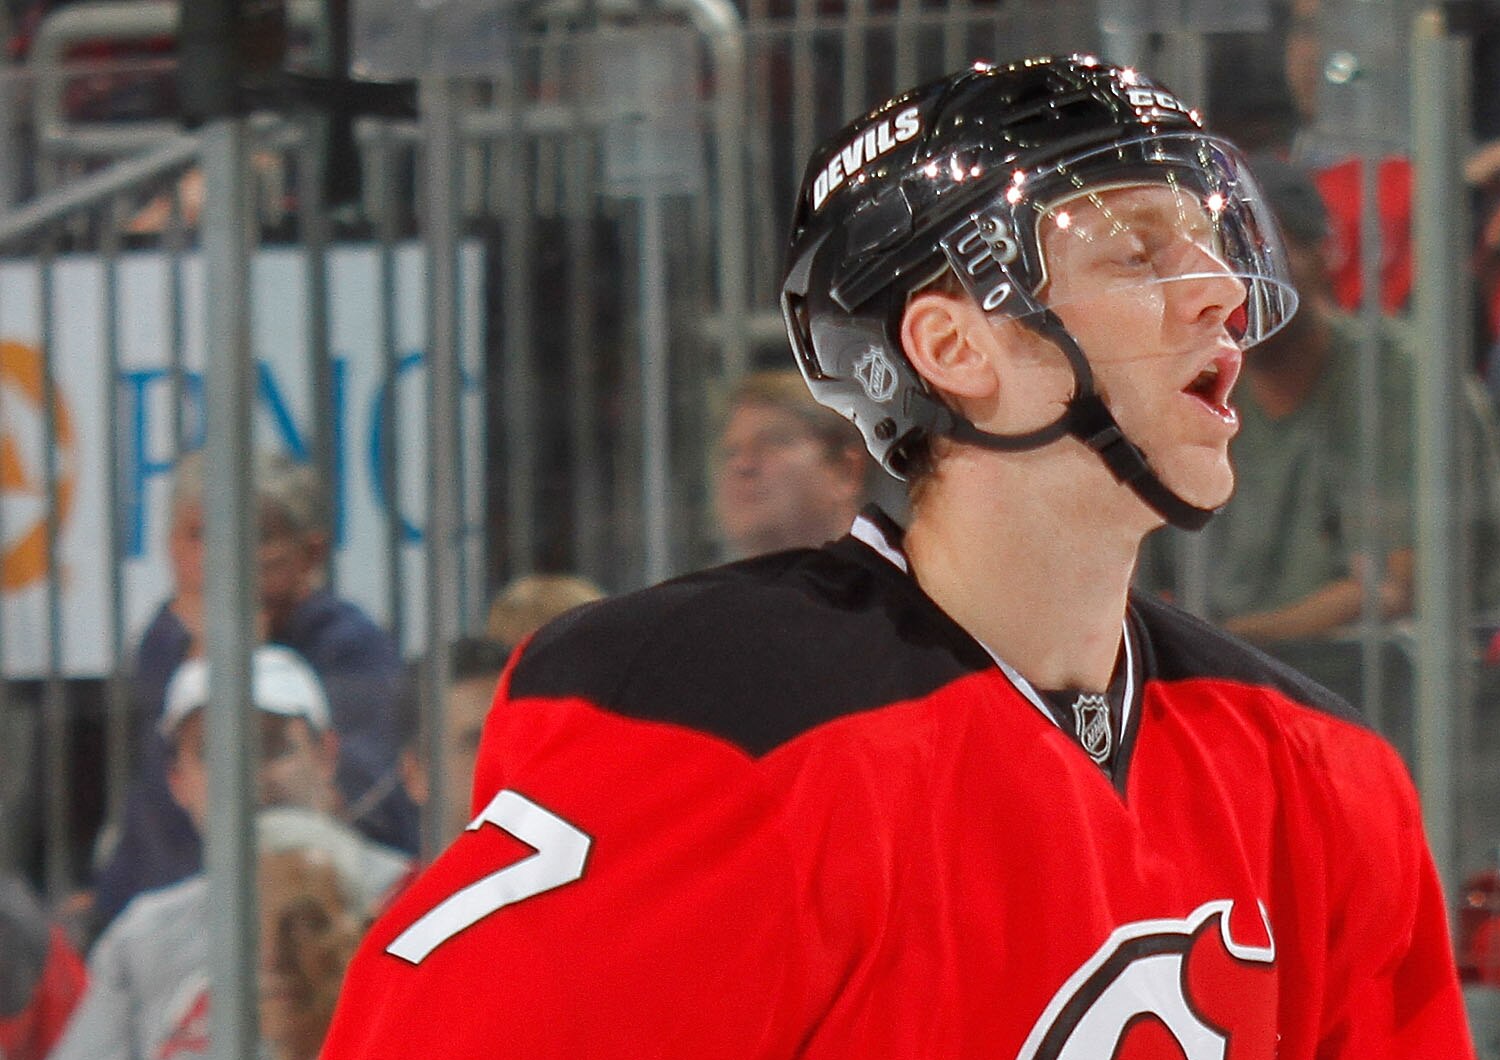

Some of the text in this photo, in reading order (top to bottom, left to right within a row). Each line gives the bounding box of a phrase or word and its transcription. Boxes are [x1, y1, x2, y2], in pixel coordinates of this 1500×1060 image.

[813, 106, 920, 211] DEVILS
[116, 350, 486, 560] PNC
[383, 788, 594, 967] 7
